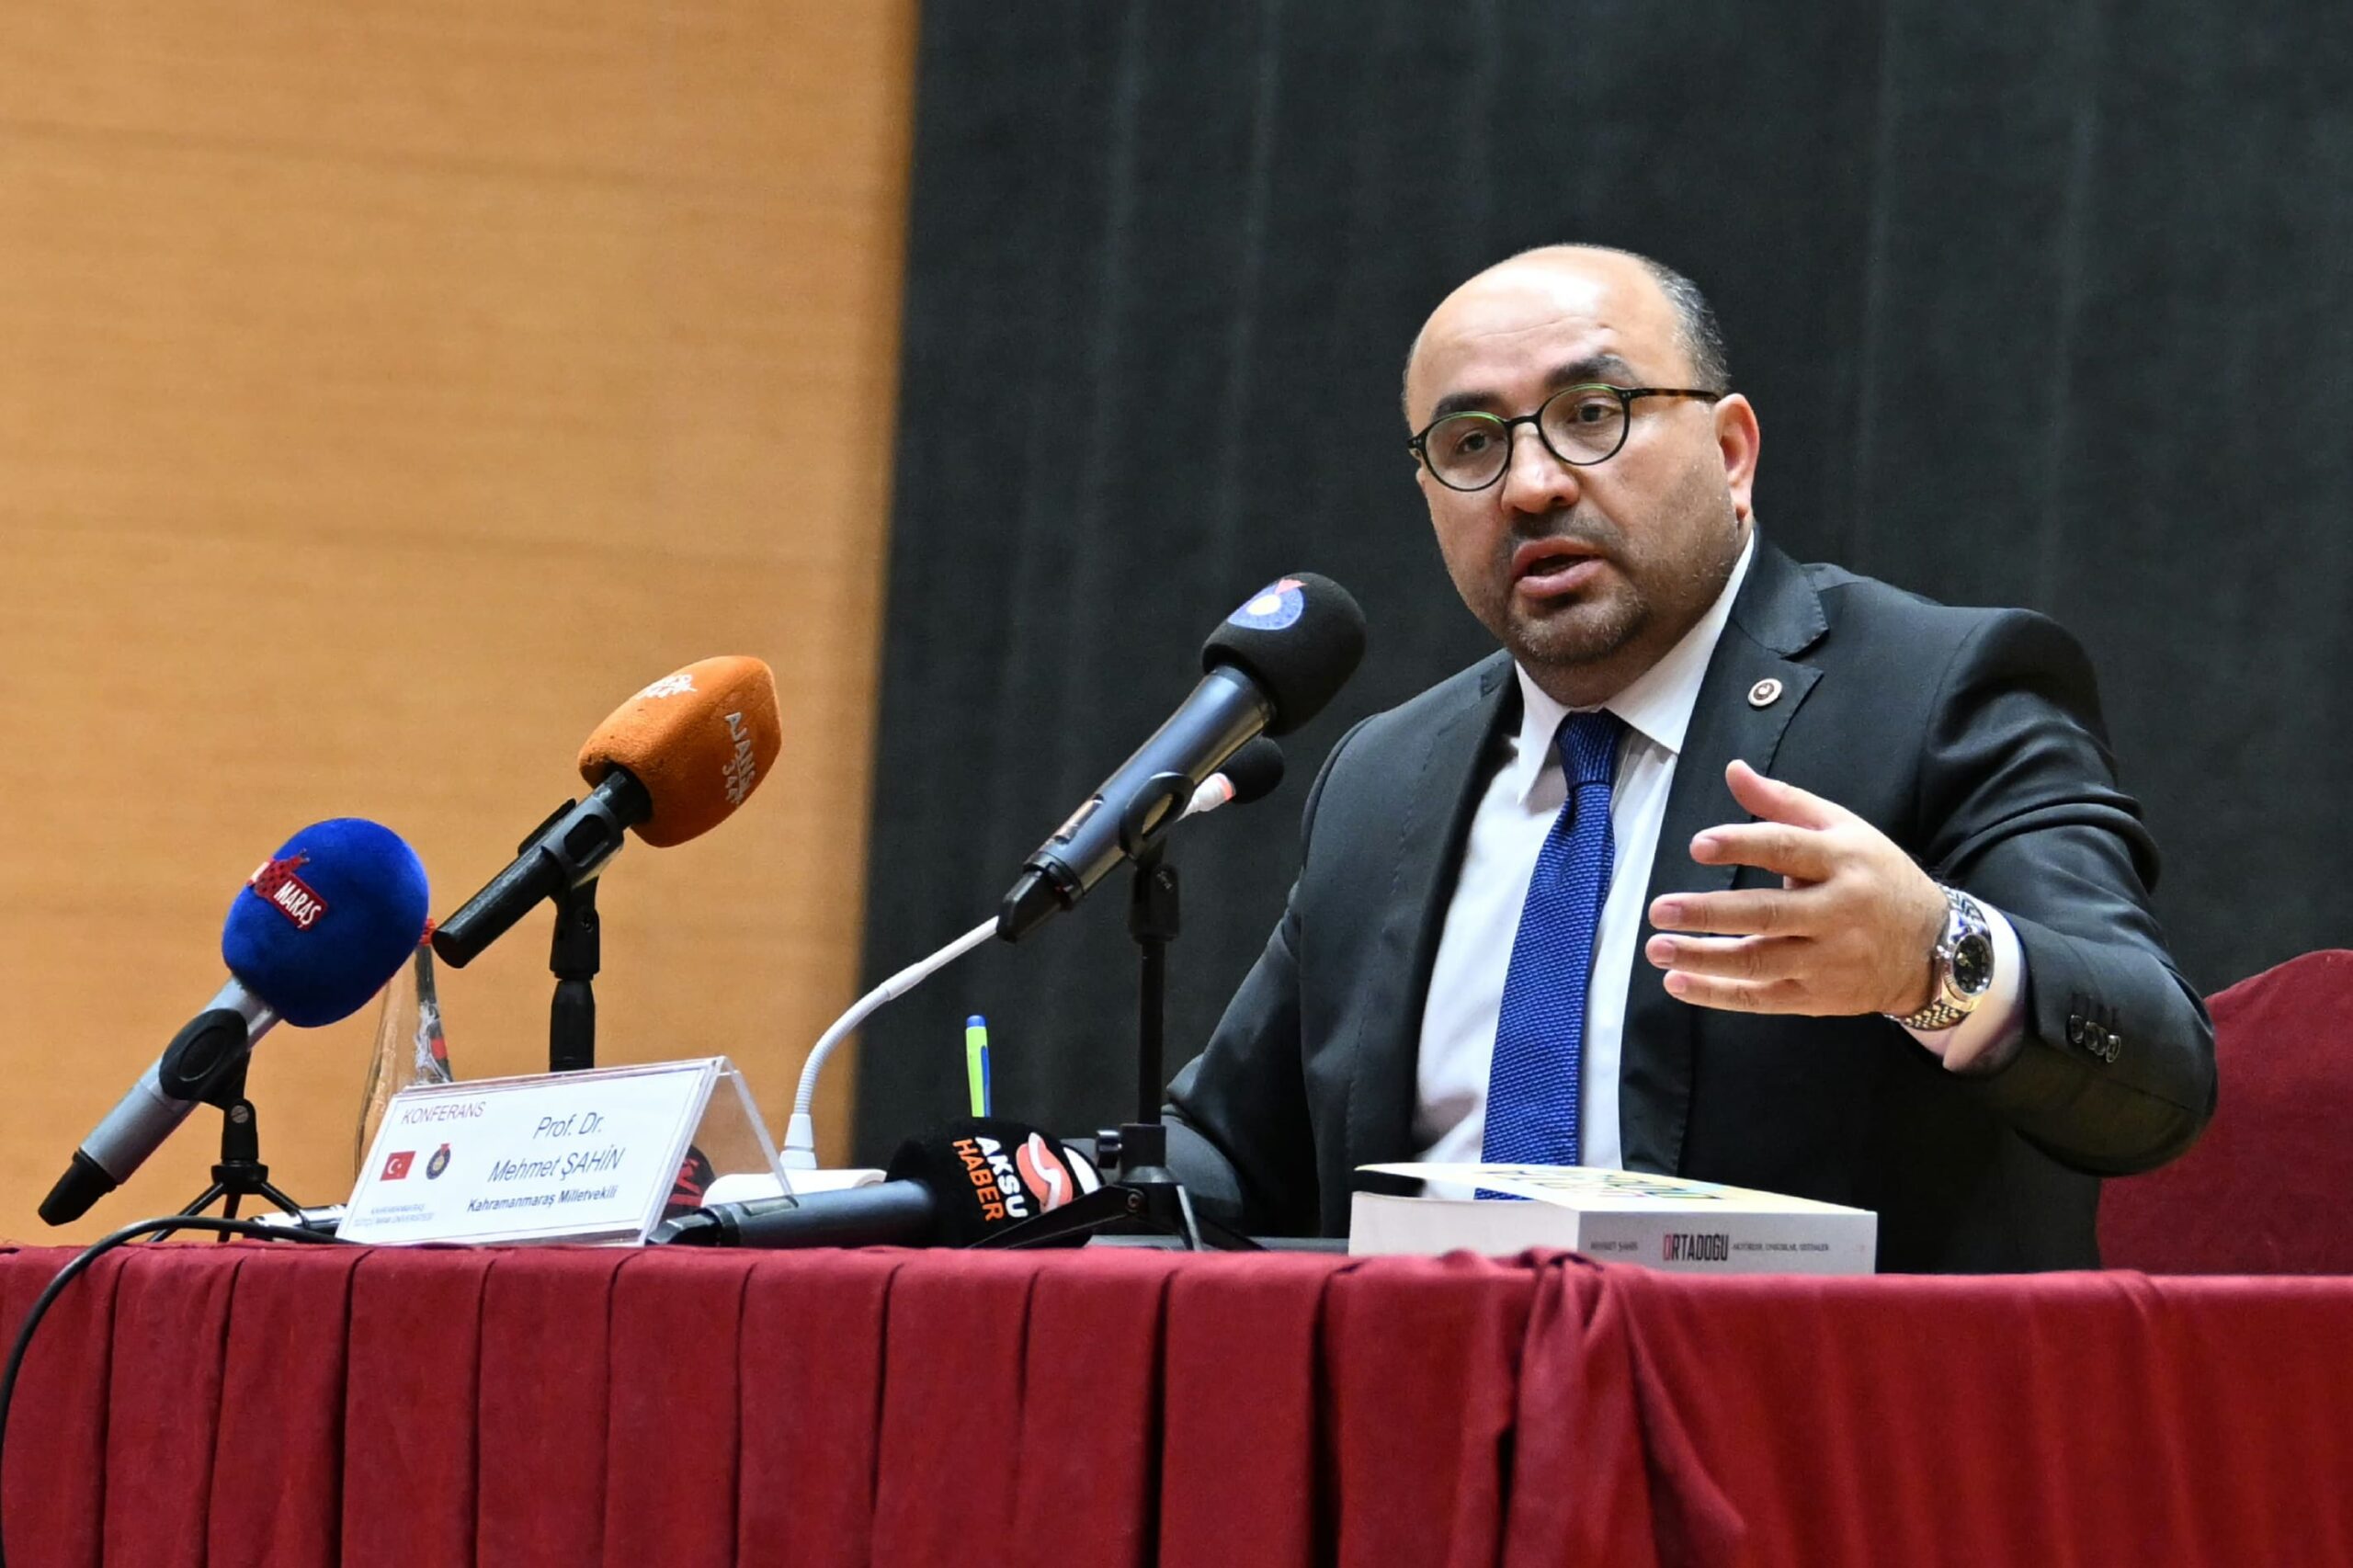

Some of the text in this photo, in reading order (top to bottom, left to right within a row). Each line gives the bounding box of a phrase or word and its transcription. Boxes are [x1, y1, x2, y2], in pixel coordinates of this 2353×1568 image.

[274, 881, 322, 929] MARAŞ
[401, 1101, 486, 1124] KONFERANS
[532, 1111, 605, 1140] Prof. Dr.
[487, 1143, 626, 1183] Mehmet ŞAHİN
[952, 1138, 1005, 1221] HABER
[975, 1136, 1029, 1219] AKSU
[467, 1185, 619, 1213] Kahramanmaraş Milletvekili
